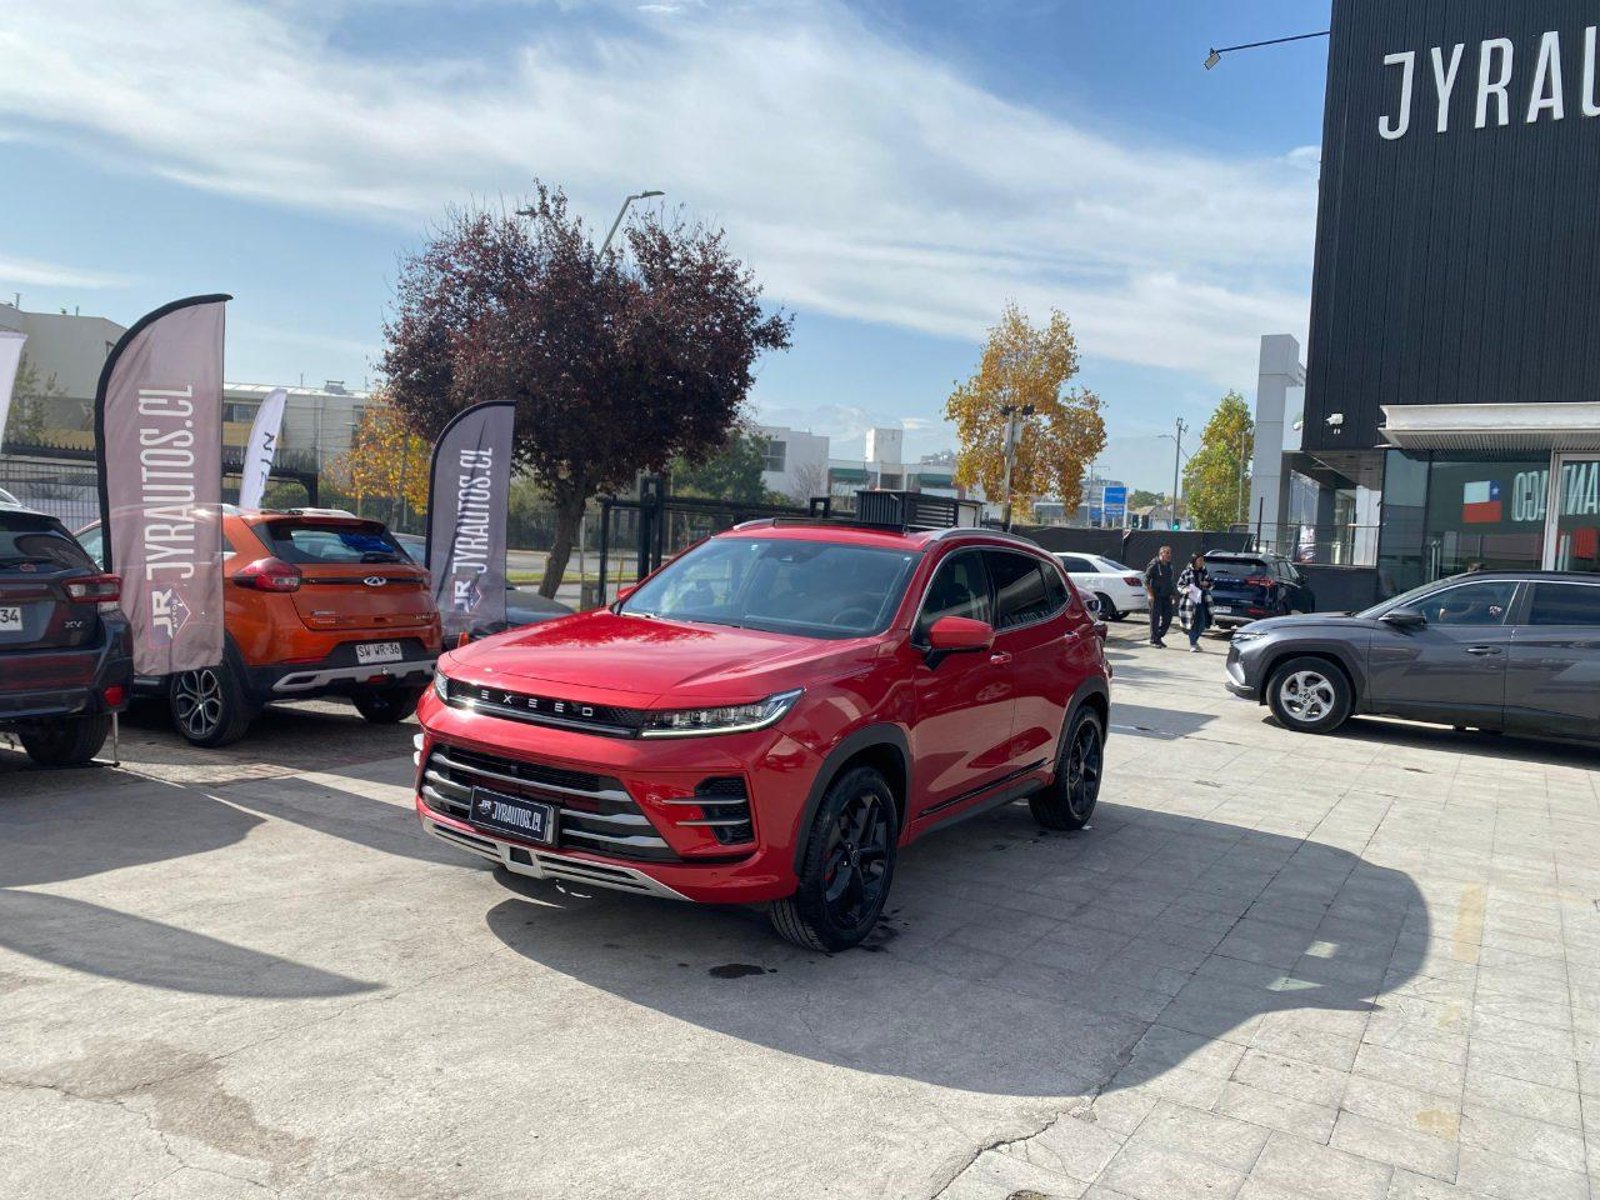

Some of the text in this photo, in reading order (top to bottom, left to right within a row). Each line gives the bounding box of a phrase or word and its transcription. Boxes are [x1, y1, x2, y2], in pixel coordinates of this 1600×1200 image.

[138, 384, 195, 580] JYRAUTOS.CL
[452, 447, 493, 574] JYRAUTOS.CL
[151, 588, 173, 639] JR
[481, 689, 593, 717] EXEED
[492, 801, 542, 832] JYRAUTOS.CL
